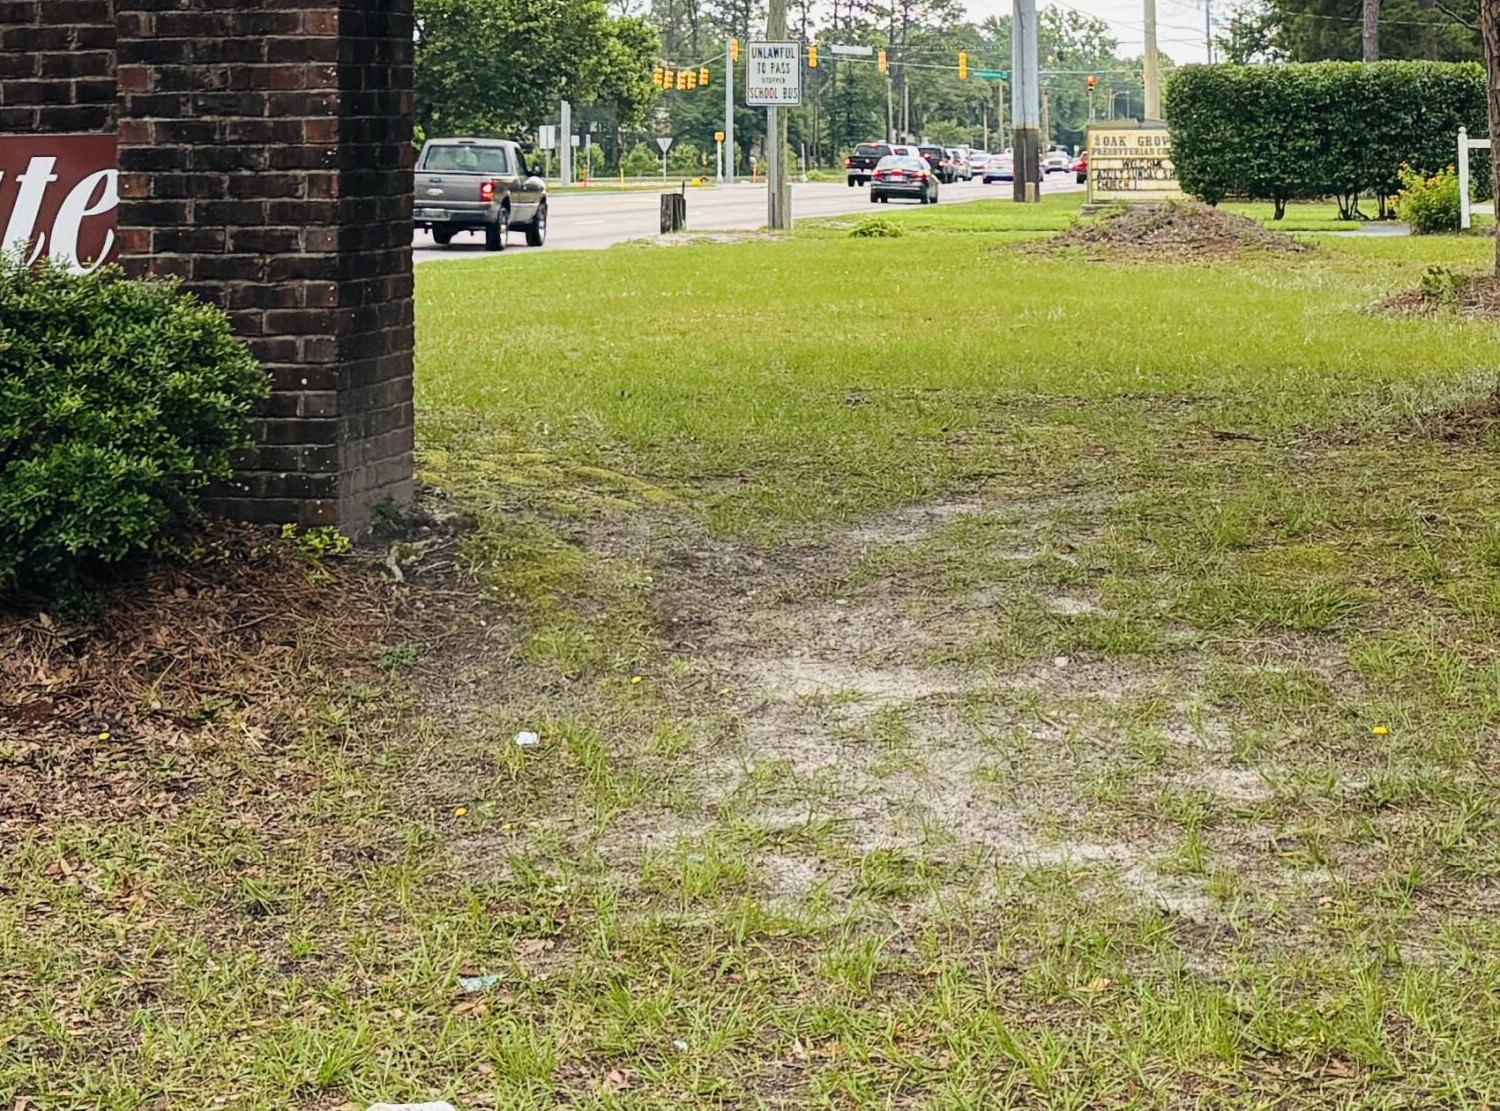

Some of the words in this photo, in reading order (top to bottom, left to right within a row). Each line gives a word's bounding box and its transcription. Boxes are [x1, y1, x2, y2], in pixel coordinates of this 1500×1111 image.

[751, 47, 795, 59] UNLAWFUL
[757, 62, 766, 74] TO
[771, 62, 790, 74] PASS
[750, 87, 778, 99] SCHOOL
[783, 87, 798, 99] BUS
[1103, 136, 1127, 147] OAK
[1137, 136, 1171, 147] GROV
